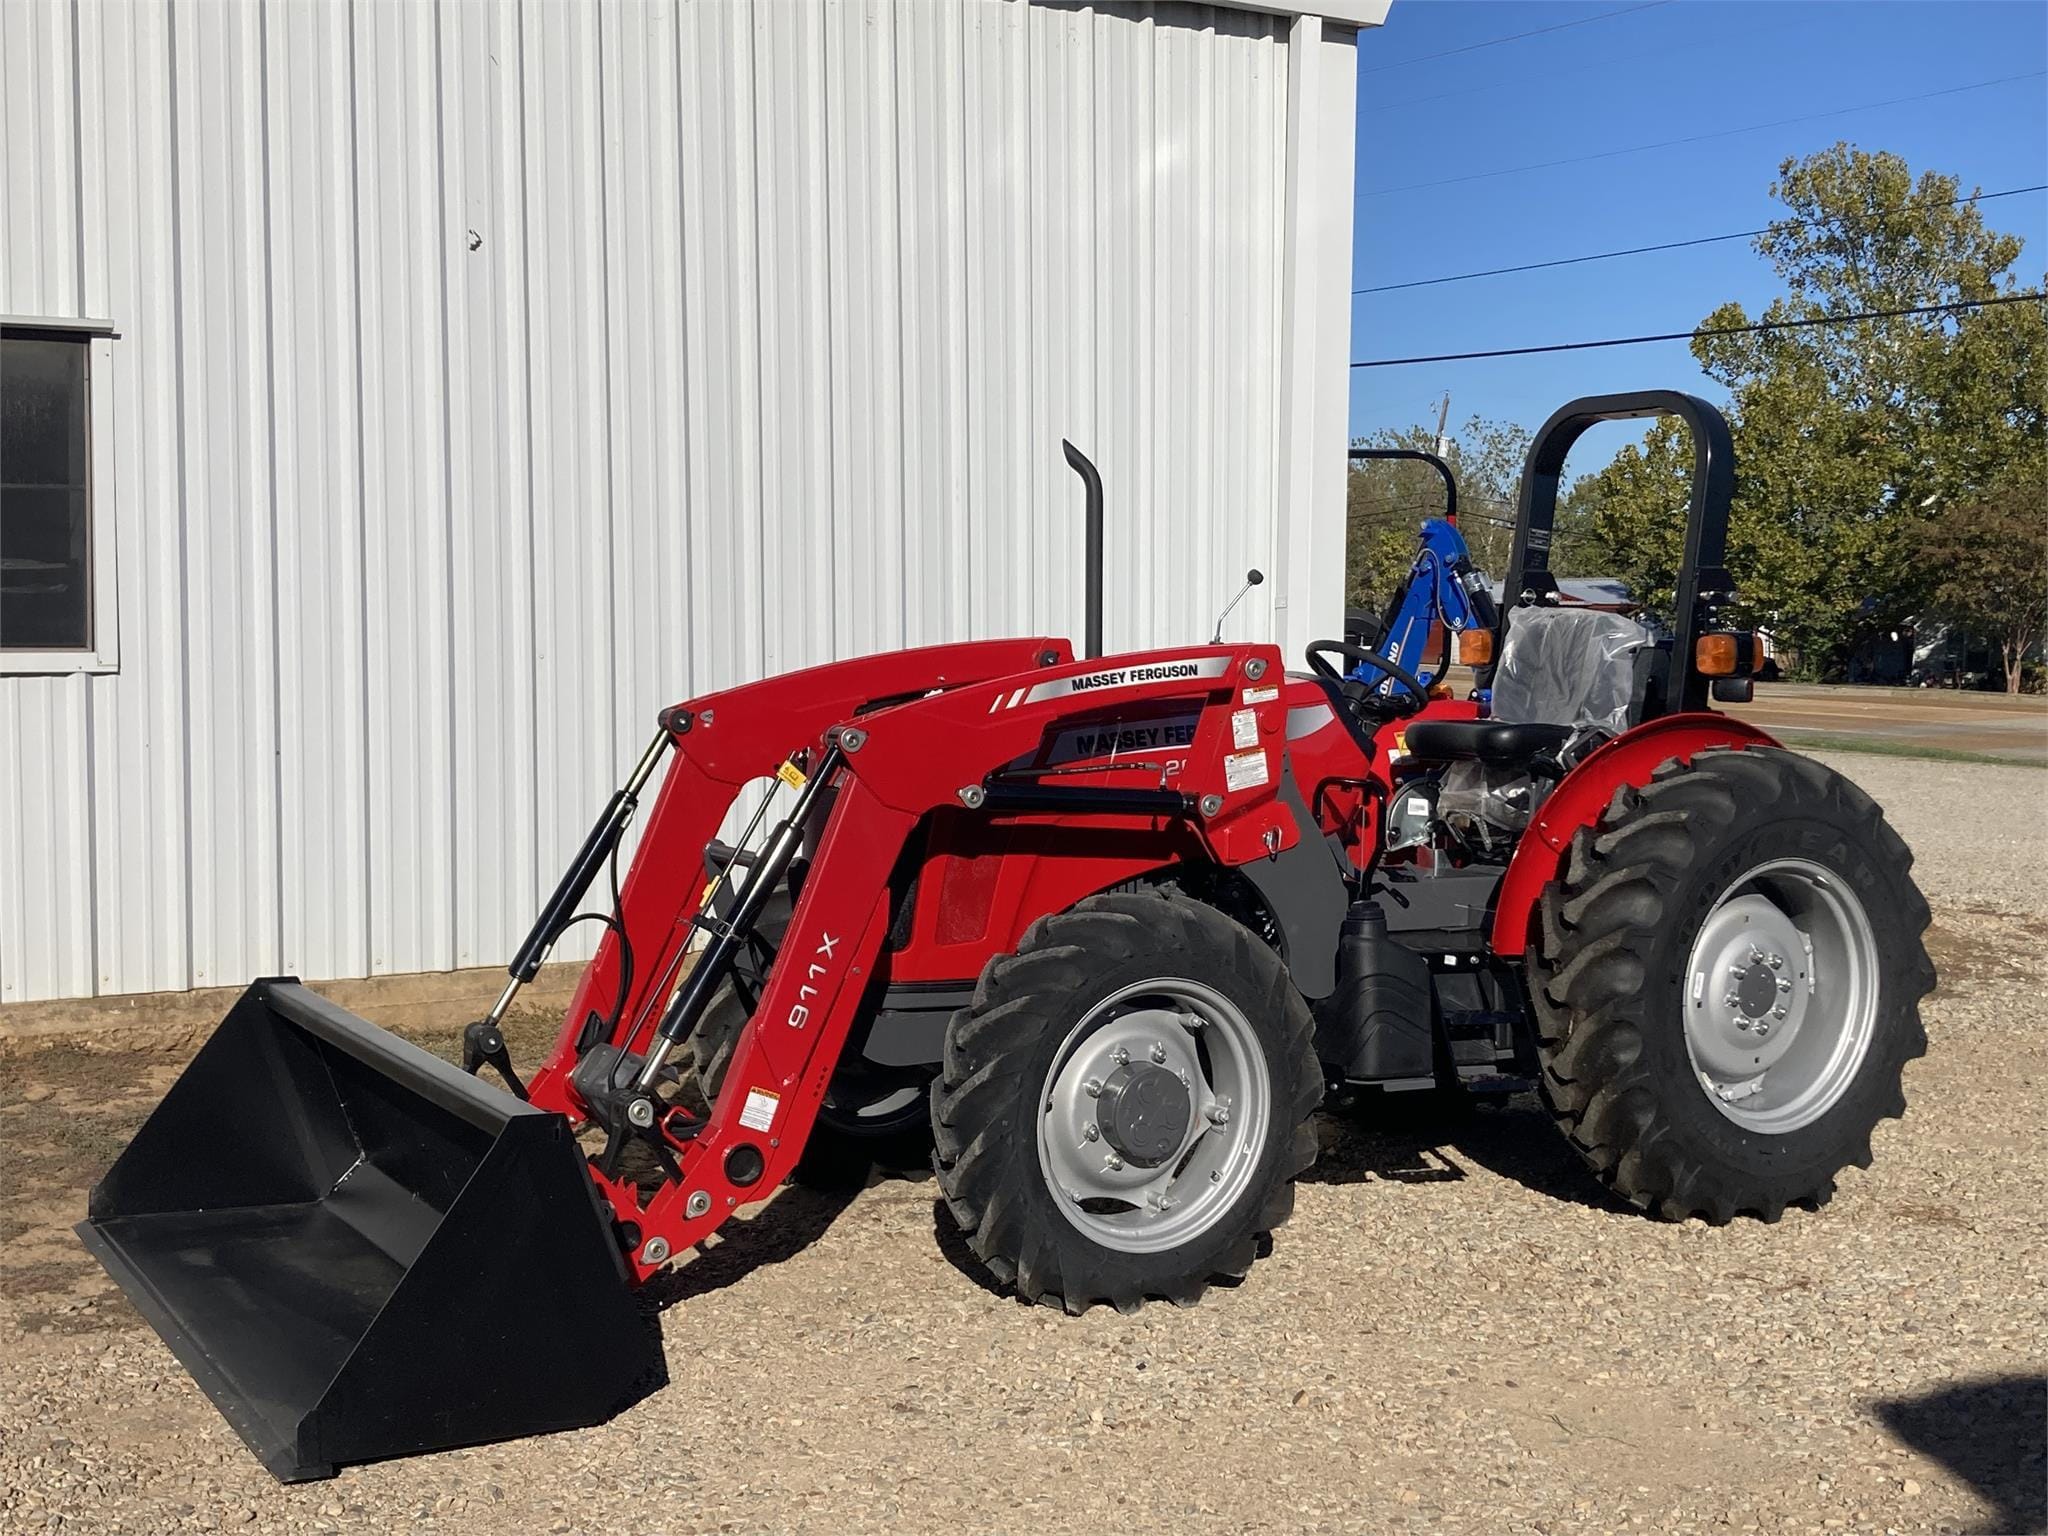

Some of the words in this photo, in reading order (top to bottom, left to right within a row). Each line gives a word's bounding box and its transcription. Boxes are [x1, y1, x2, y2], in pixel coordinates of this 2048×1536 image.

[1072, 672, 1126, 691] MASSEY
[1130, 664, 1198, 682] FERGUSON
[1076, 728, 1159, 754] MASSEY
